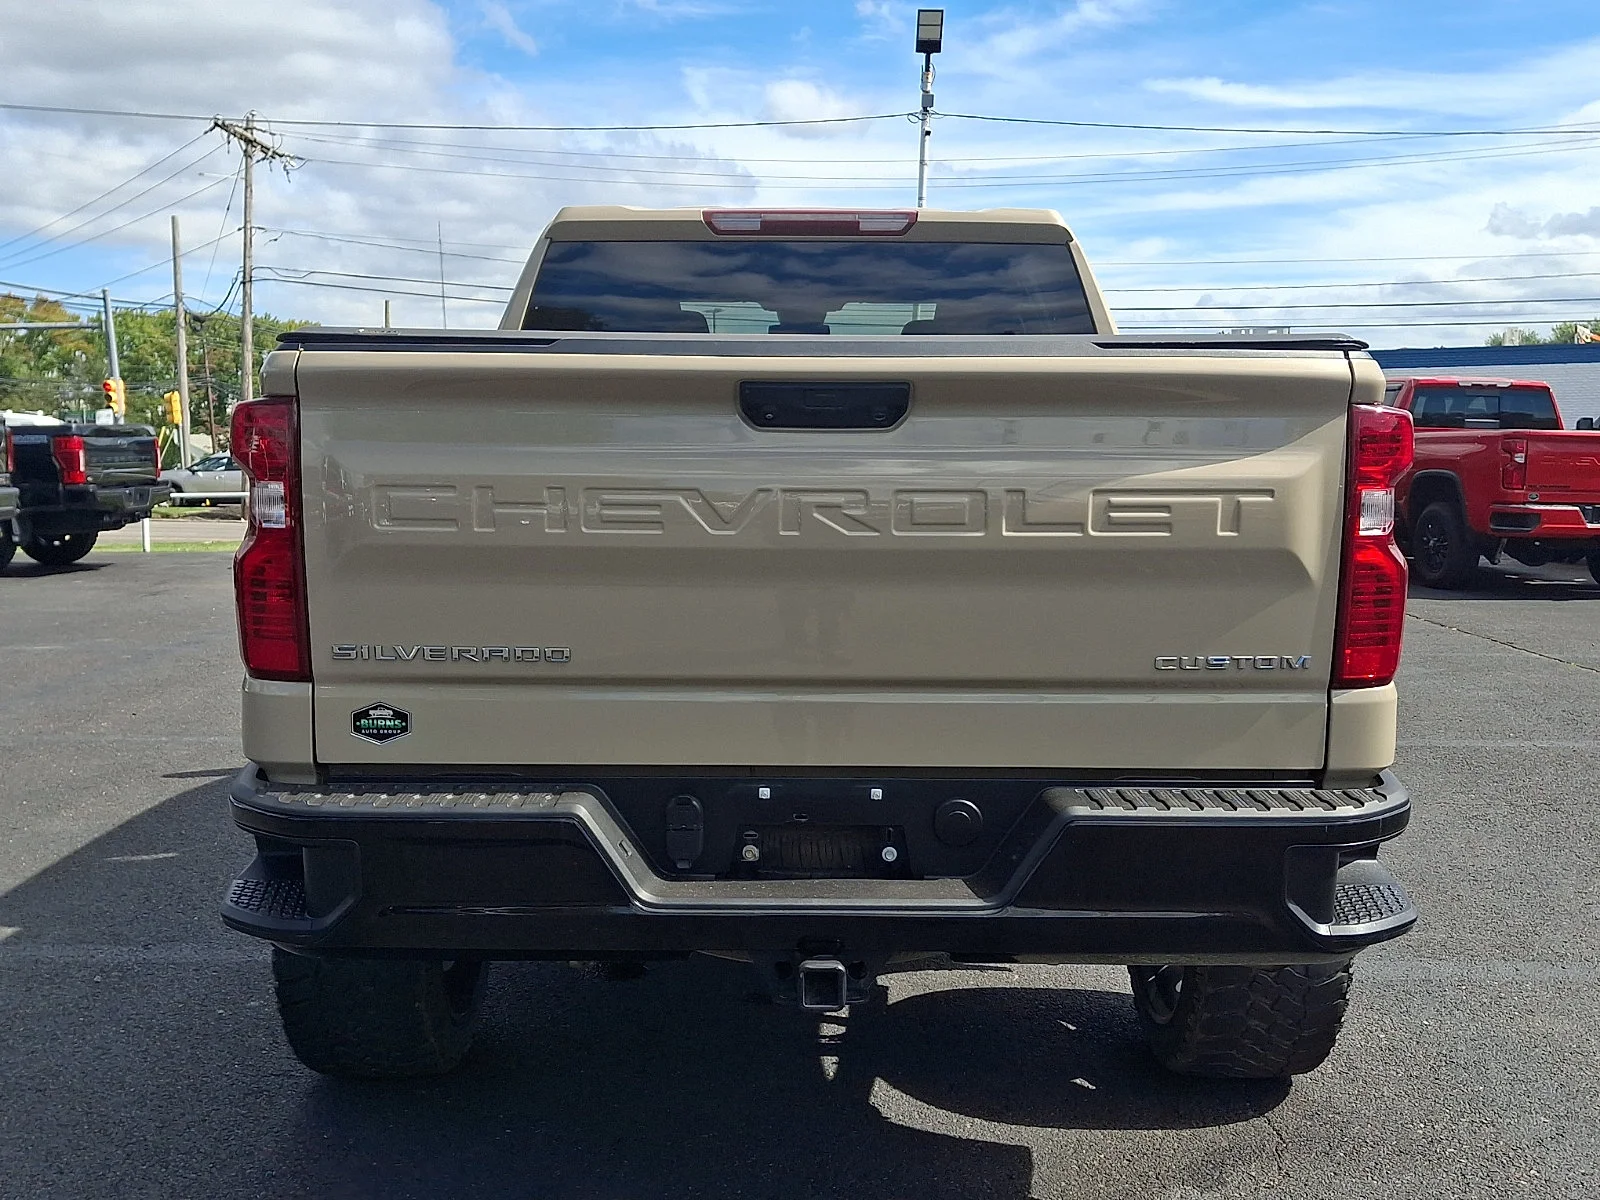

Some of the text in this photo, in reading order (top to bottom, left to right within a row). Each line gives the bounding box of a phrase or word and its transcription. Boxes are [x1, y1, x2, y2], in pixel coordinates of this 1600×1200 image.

[370, 484, 1276, 536] CHEVROLET
[332, 644, 571, 662] SILVERADO
[1154, 655, 1312, 670] CUSTOM
[360, 719, 402, 728] BURNS
